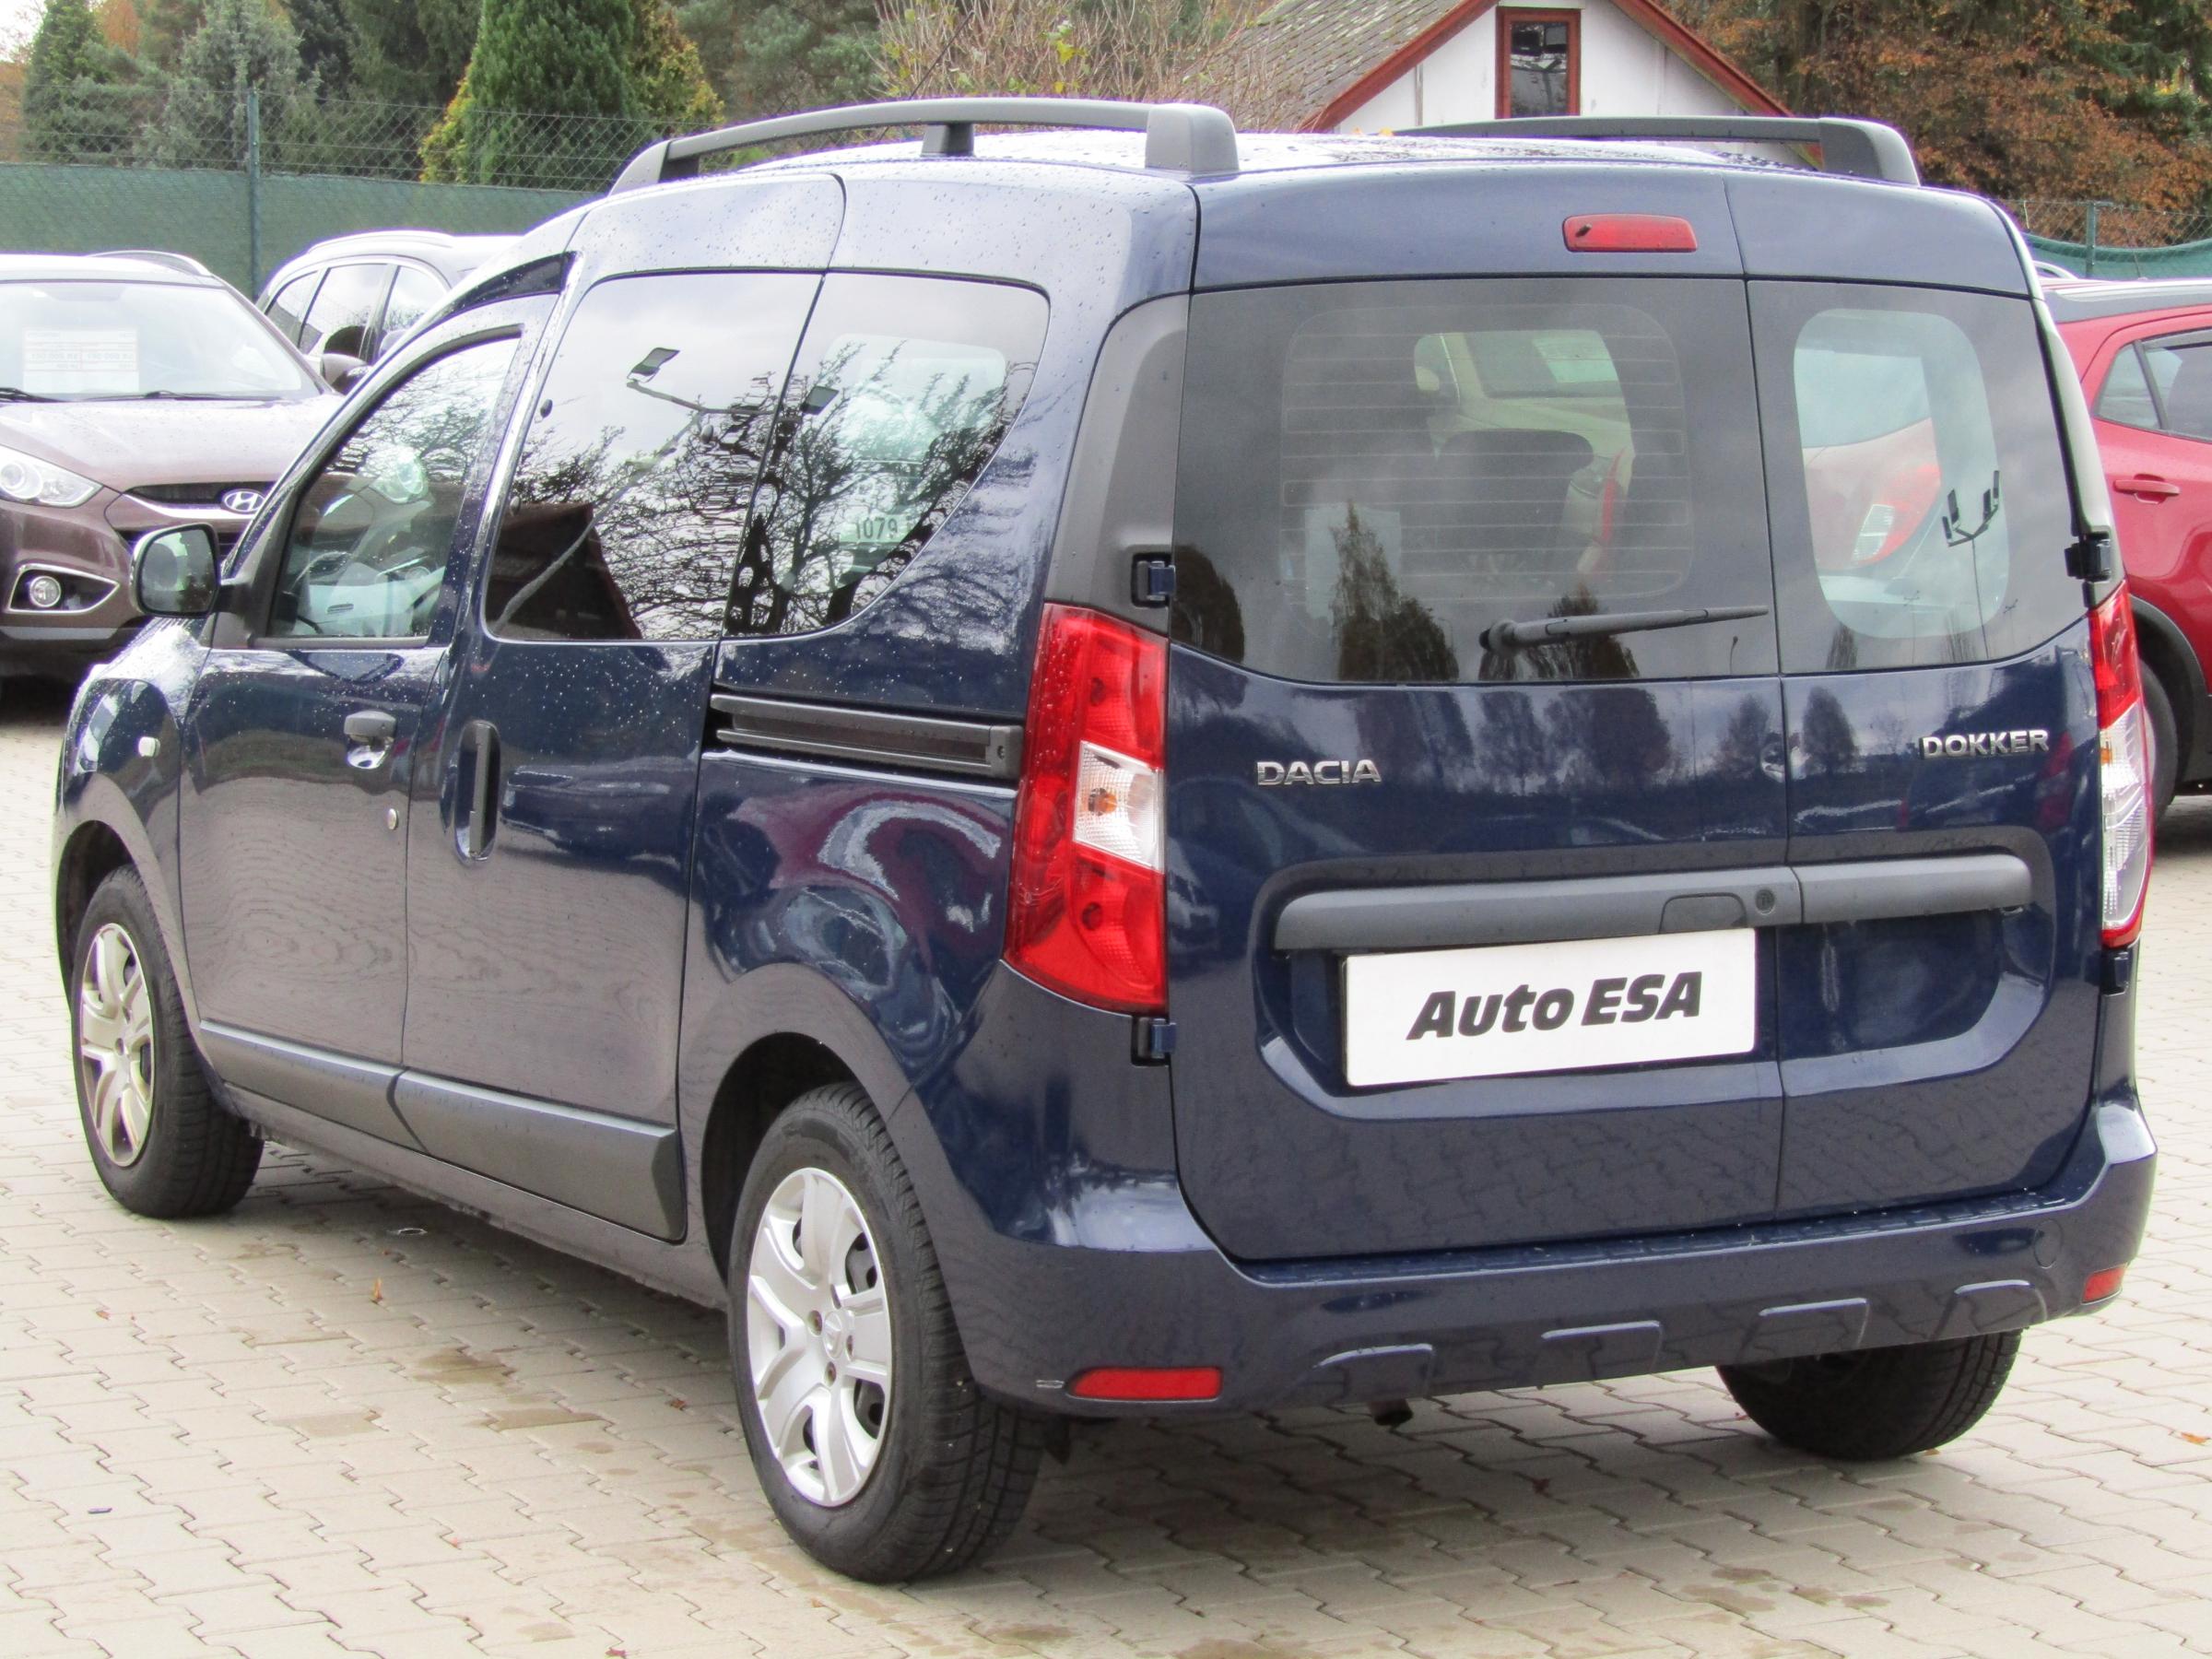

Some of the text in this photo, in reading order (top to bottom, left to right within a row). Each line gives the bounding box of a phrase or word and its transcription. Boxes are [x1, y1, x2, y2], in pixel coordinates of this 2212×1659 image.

[1919, 729, 2051, 759] DOKKER
[1256, 759, 1382, 786] DACIA
[1406, 971, 1703, 1041] Auto ESA
